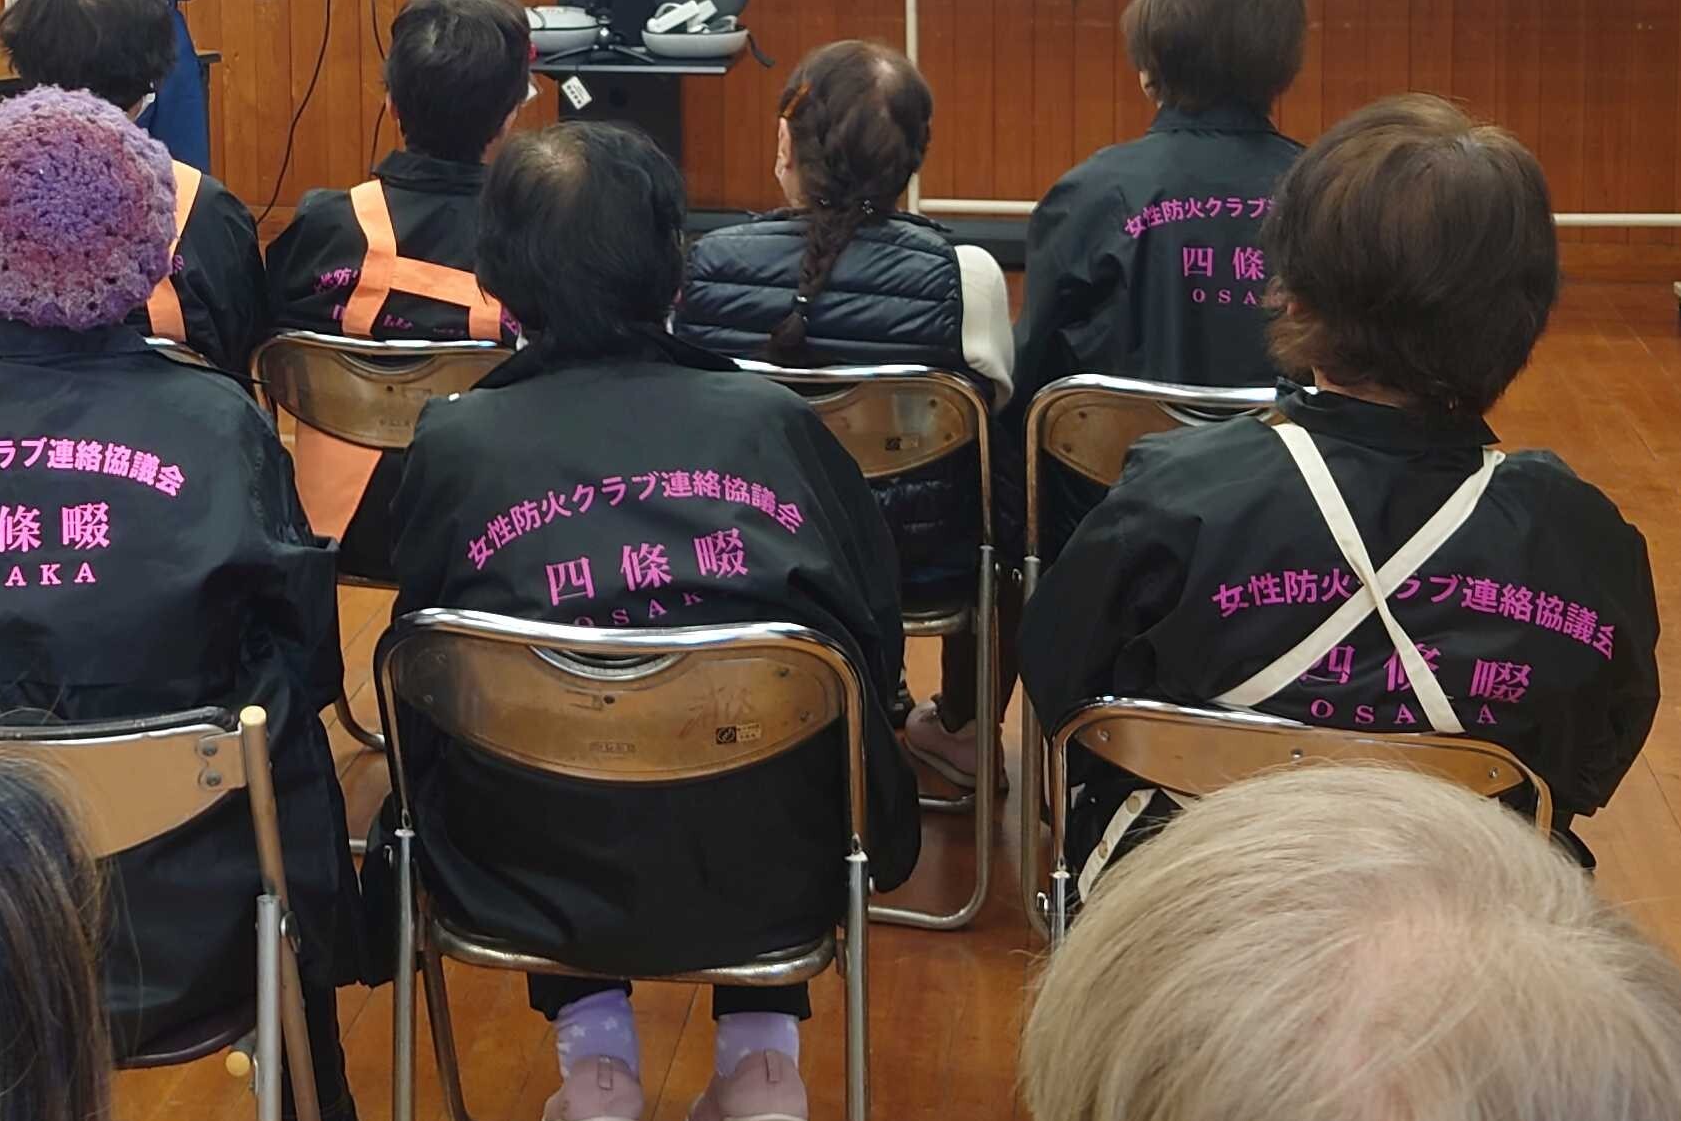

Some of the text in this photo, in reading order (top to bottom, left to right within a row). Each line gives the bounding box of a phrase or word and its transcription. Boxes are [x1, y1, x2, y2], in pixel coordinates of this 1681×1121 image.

[1124, 196, 1276, 239] 女性防火クラブ
[1181, 246, 1265, 281] 四條
[1191, 287, 1258, 305] OSA
[466, 469, 806, 571] 女性防火クラブ連絡協議会
[545, 526, 749, 607] 四條畷
[573, 590, 704, 627] OSAK
[1210, 566, 1617, 662] 女性防火ラブ連絡協議会
[1309, 697, 1499, 726] OSAA
